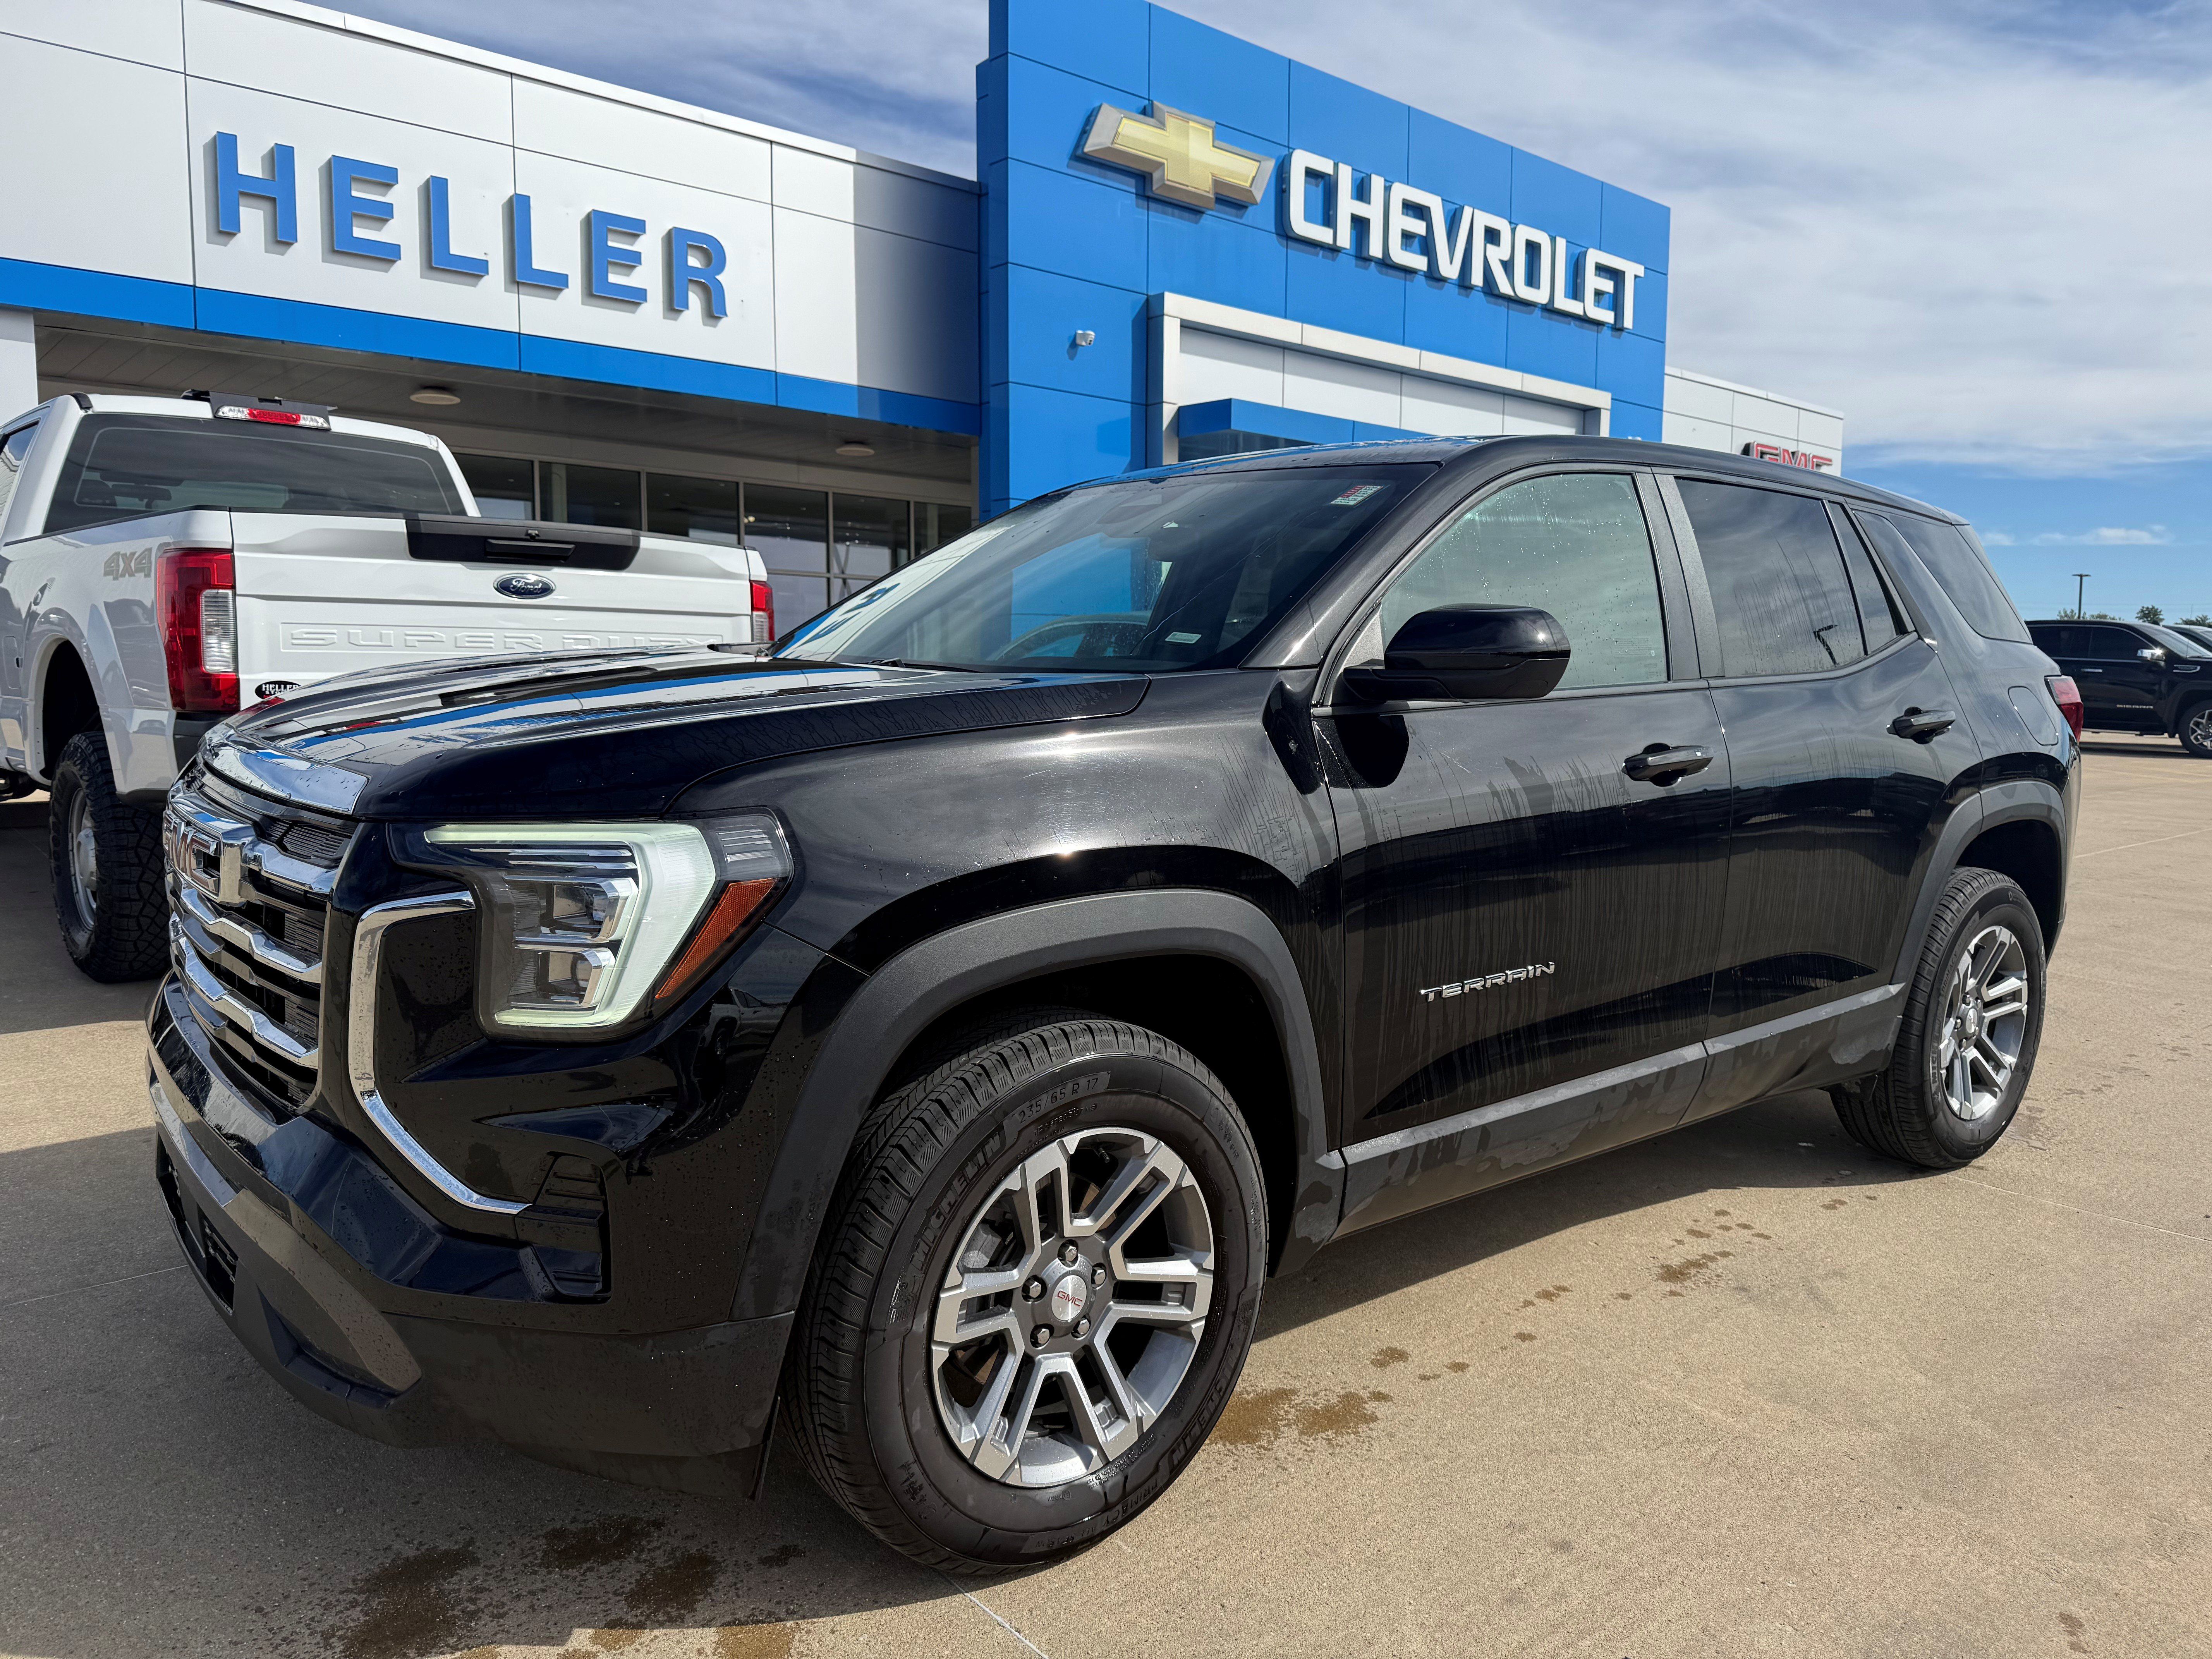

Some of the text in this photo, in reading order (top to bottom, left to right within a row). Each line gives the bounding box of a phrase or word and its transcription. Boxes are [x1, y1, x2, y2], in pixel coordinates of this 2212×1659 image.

[214, 131, 728, 318] HELLER
[1284, 148, 1645, 330] CHEVROLET
[510, 578, 542, 593] Ford
[290, 629, 543, 651] SUPER
[1420, 961, 1555, 1002] TERRAIN
[1020, 1078, 1099, 1123] 235/65 R 17
[909, 1132, 1001, 1273] MICHELIN
[1057, 1290, 1083, 1307] GMC
[1172, 1349, 1241, 1468] MICHELIN
[1103, 1477, 1159, 1527] PRIMACY
